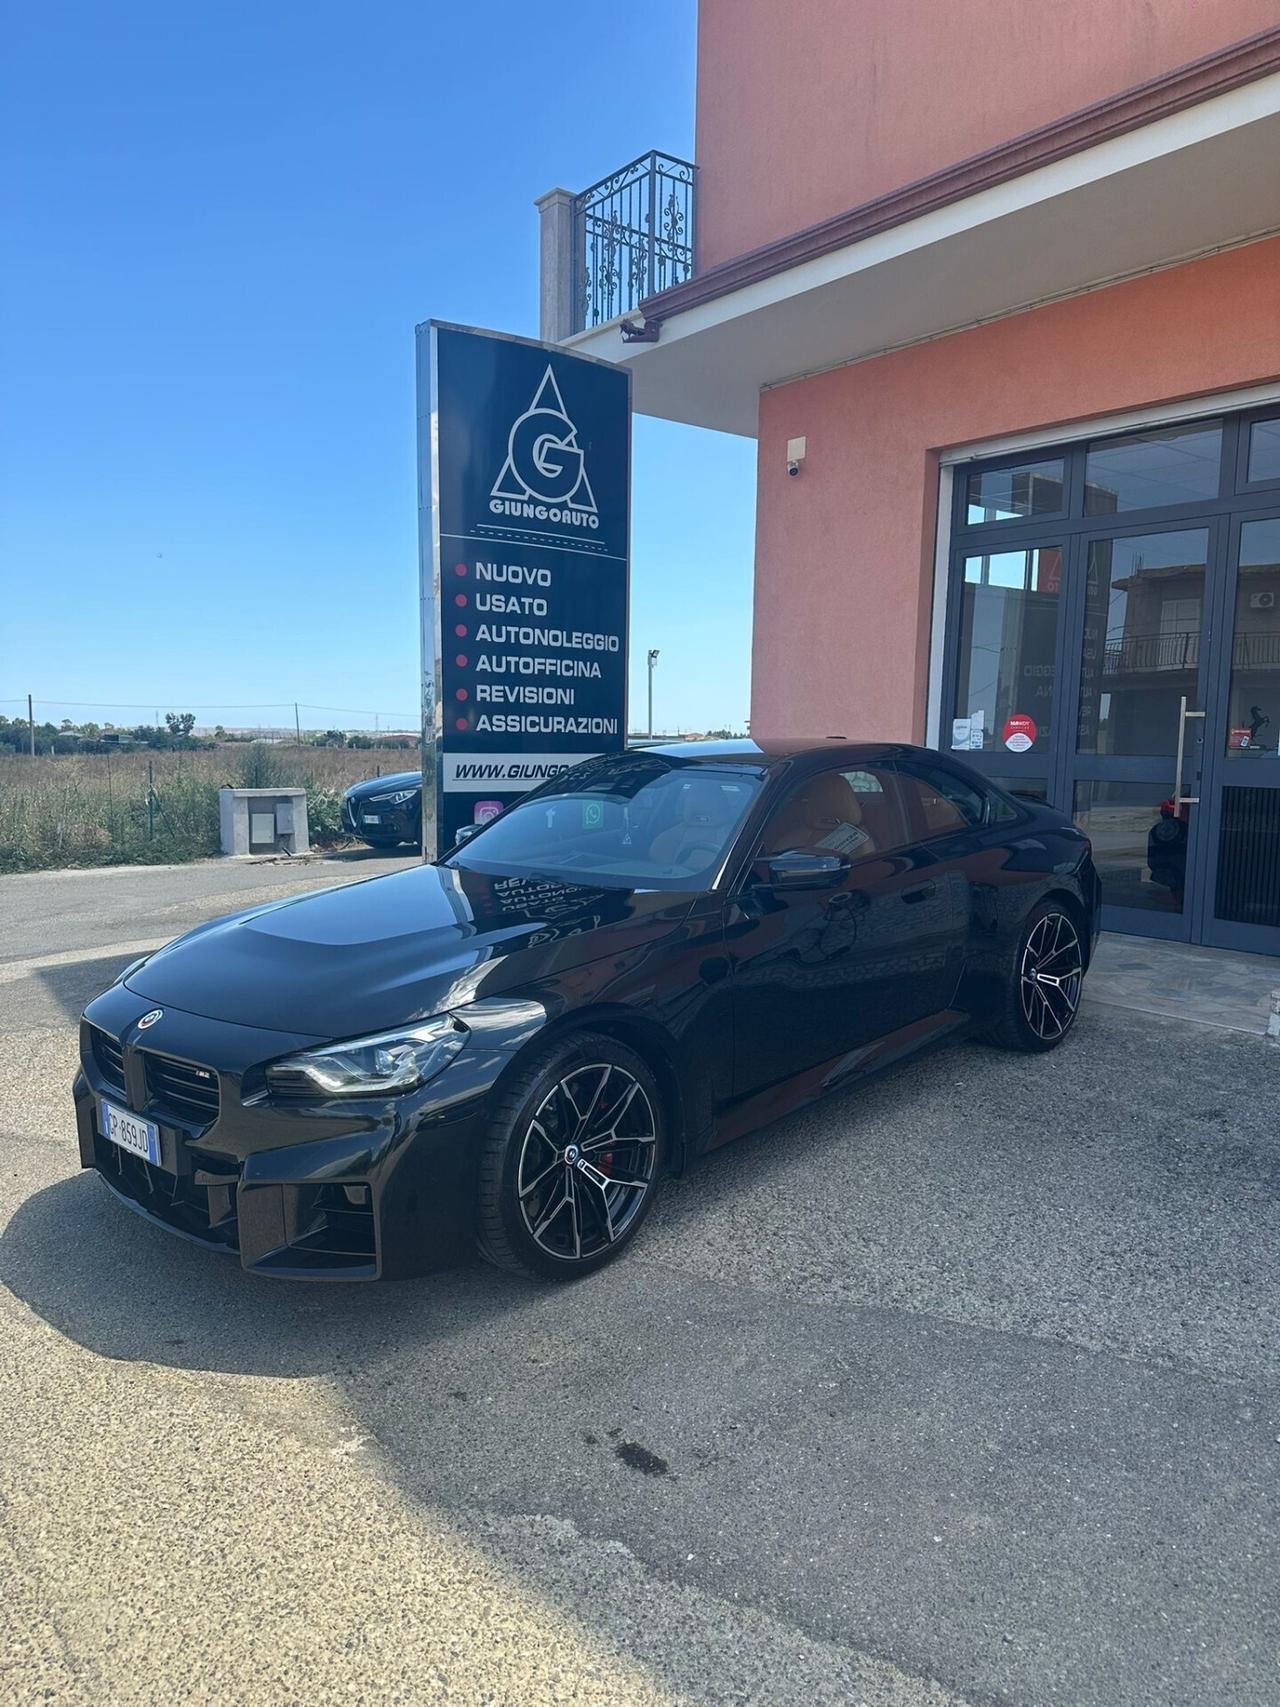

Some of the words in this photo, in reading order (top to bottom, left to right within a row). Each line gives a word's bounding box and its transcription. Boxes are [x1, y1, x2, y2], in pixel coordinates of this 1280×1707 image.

[489, 499, 599, 529] GIUNGOAUTO
[475, 562, 551, 587] NUOVO
[475, 593, 547, 616] USATO
[475, 624, 619, 652] AUTONOLEGGIO
[475, 654, 602, 678] AUTOFFICINA
[475, 684, 575, 705] REVISIONI
[475, 714, 618, 734] ASSICURAZIONI
